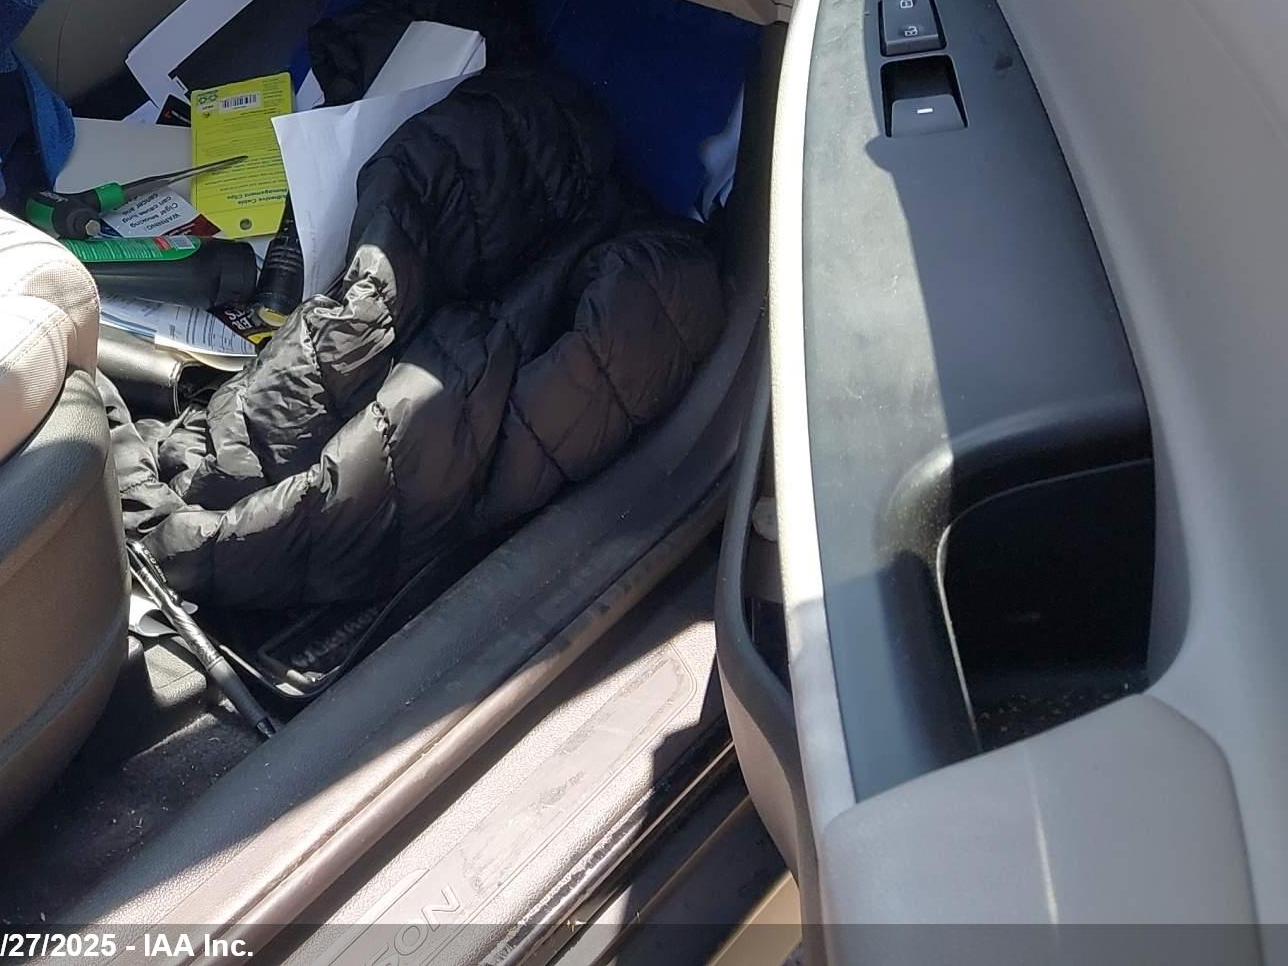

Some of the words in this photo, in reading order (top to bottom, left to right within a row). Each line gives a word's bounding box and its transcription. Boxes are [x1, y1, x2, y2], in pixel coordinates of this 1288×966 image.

[136, 193, 159, 209] cancer
[158, 196, 172, 206] can
[160, 202, 179, 215] Cigar
[121, 213, 139, 224] lung
